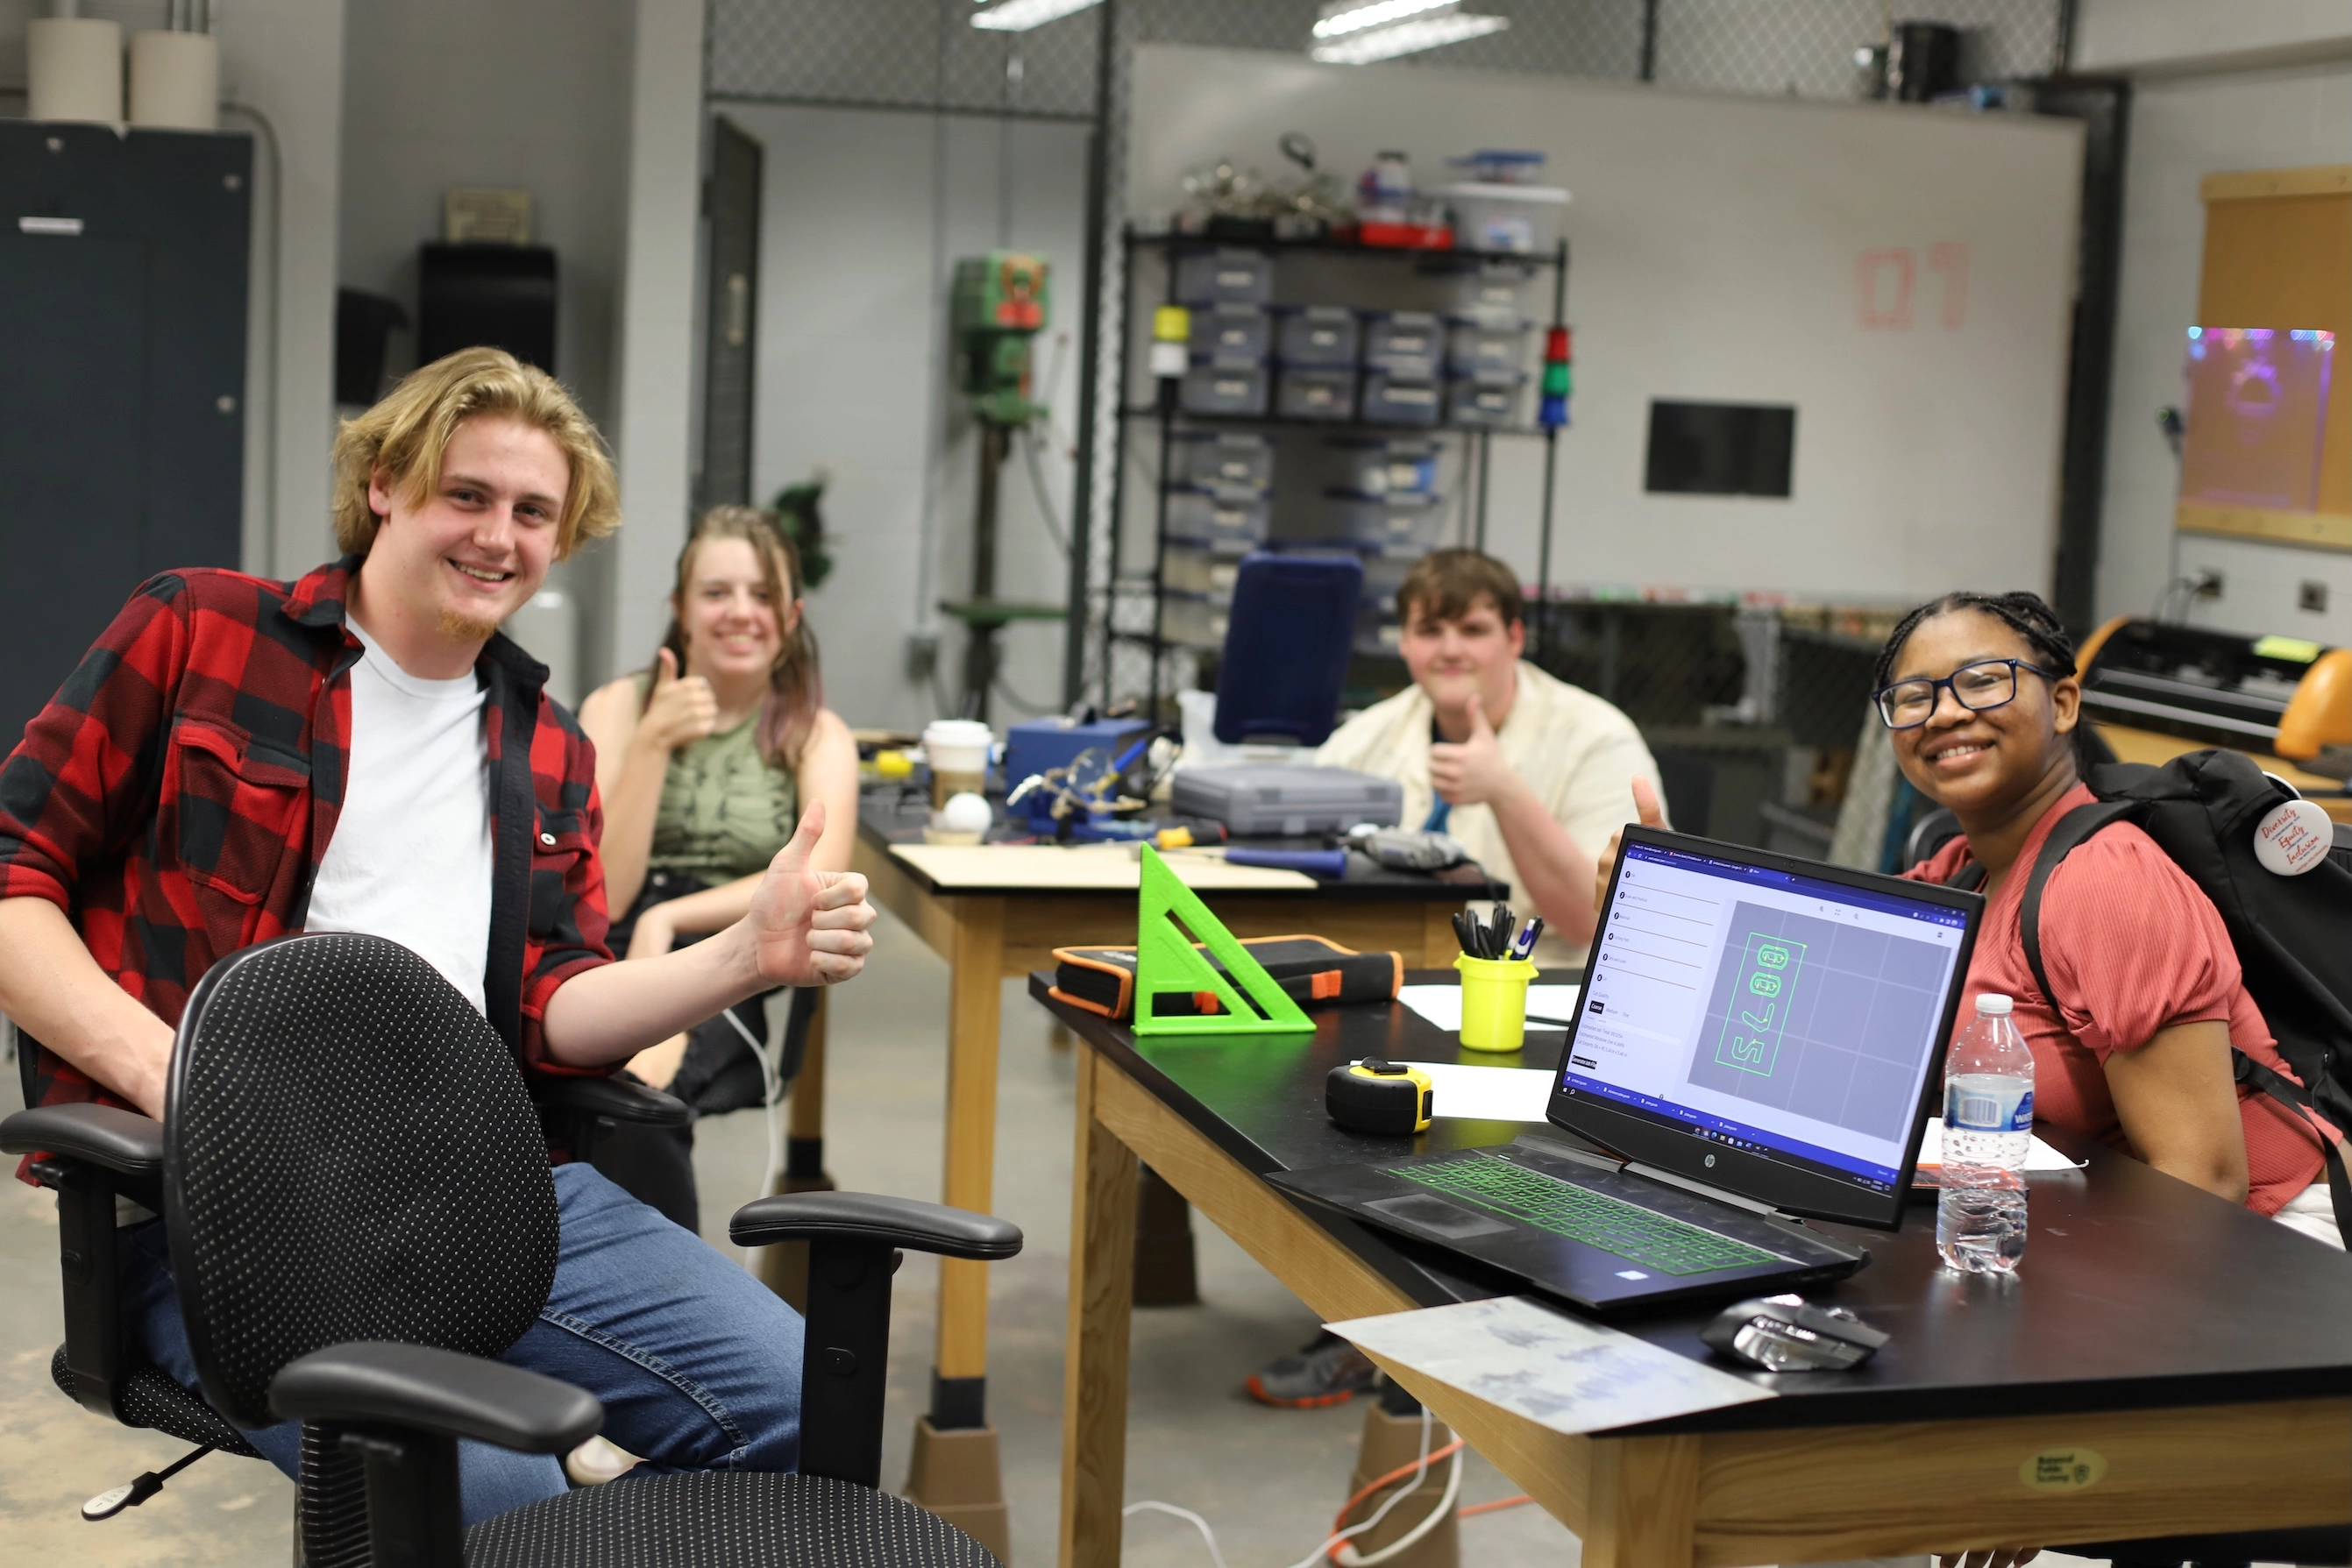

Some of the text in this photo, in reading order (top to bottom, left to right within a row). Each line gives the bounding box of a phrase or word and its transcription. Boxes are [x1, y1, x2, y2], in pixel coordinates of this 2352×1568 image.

[2262, 808, 2297, 839] Diversity
[2278, 826, 2306, 848] Equity
[2286, 835, 2320, 865] Inclusion
[1581, 1022, 1597, 1032] Estimated
[2014, 1111, 2033, 1124] WATE
